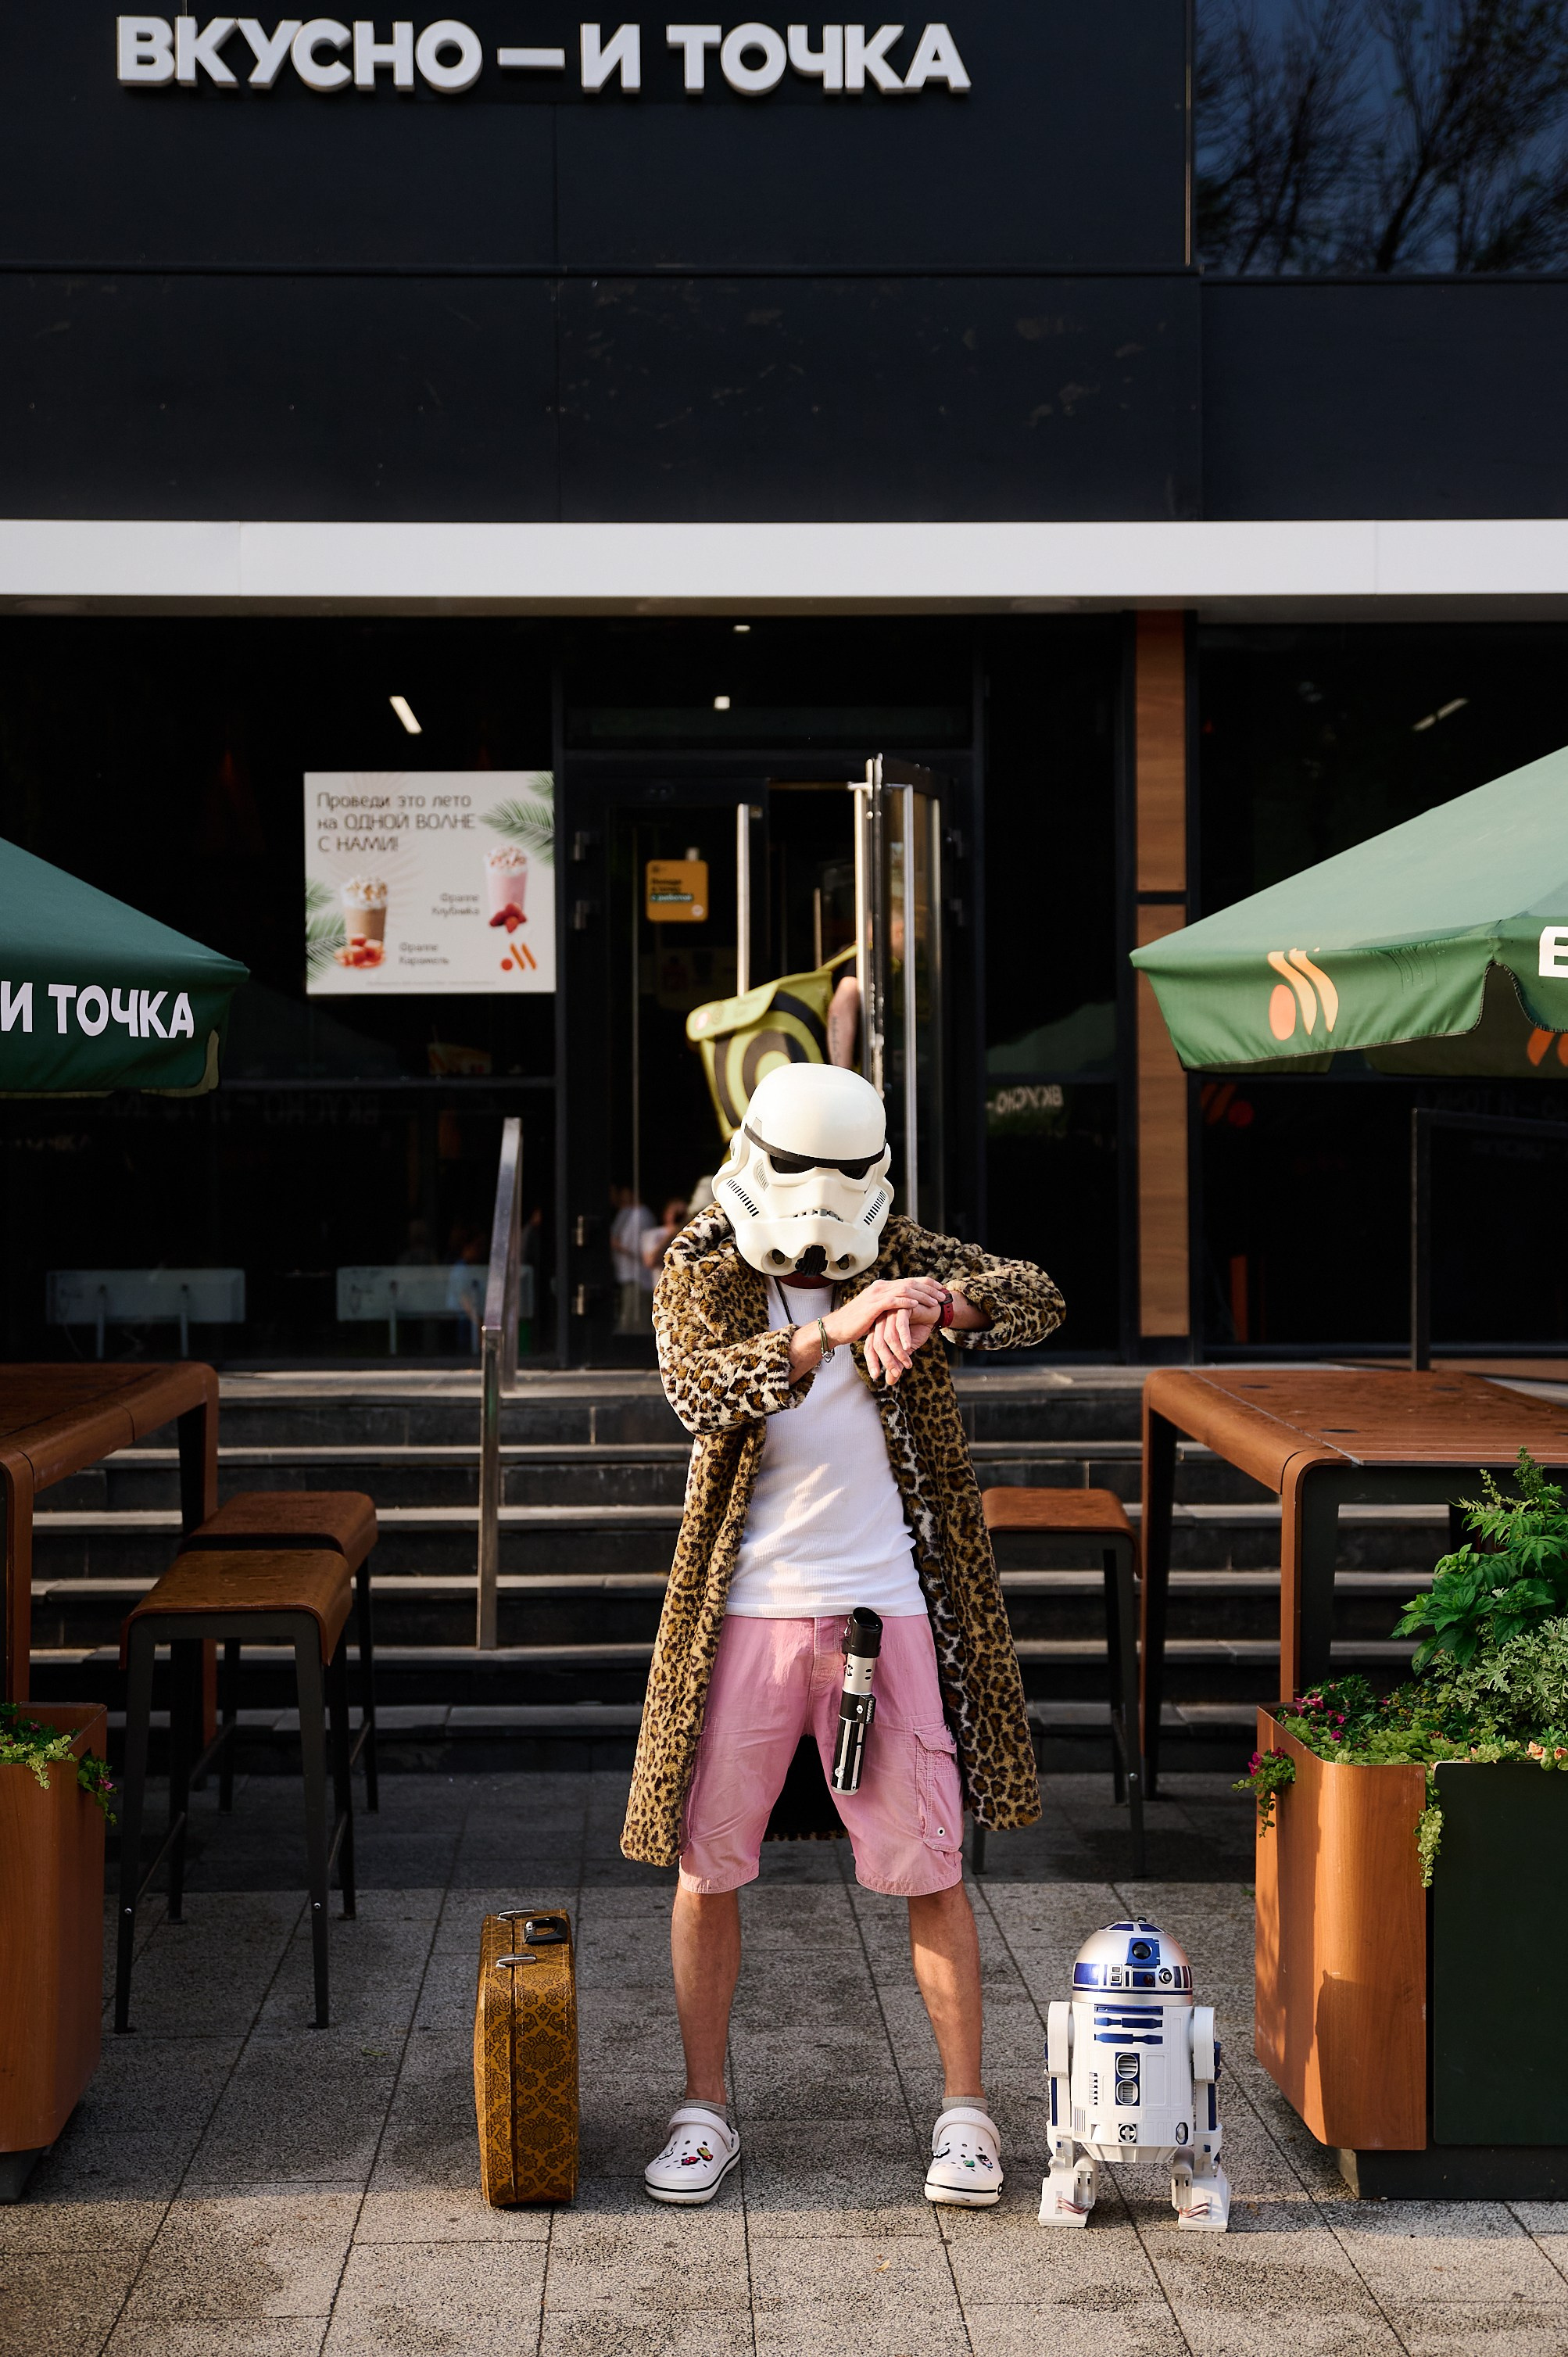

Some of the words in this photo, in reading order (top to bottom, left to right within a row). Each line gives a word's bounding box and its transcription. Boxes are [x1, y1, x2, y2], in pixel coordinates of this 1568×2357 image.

[116, 16, 483, 93] ВКУСНО
[581, 22, 640, 93] И
[667, 22, 972, 95] ТОЧКА
[317, 791, 391, 811] Проведи
[398, 795, 426, 808] это
[431, 795, 472, 808] лето
[317, 818, 338, 829] на
[344, 812, 410, 831] ОДНОЙ
[415, 813, 476, 830] ВОЛНЕ
[336, 836, 399, 852] НАМИ!
[0, 981, 33, 1033] И
[48, 983, 195, 1039] ТОЧКА
